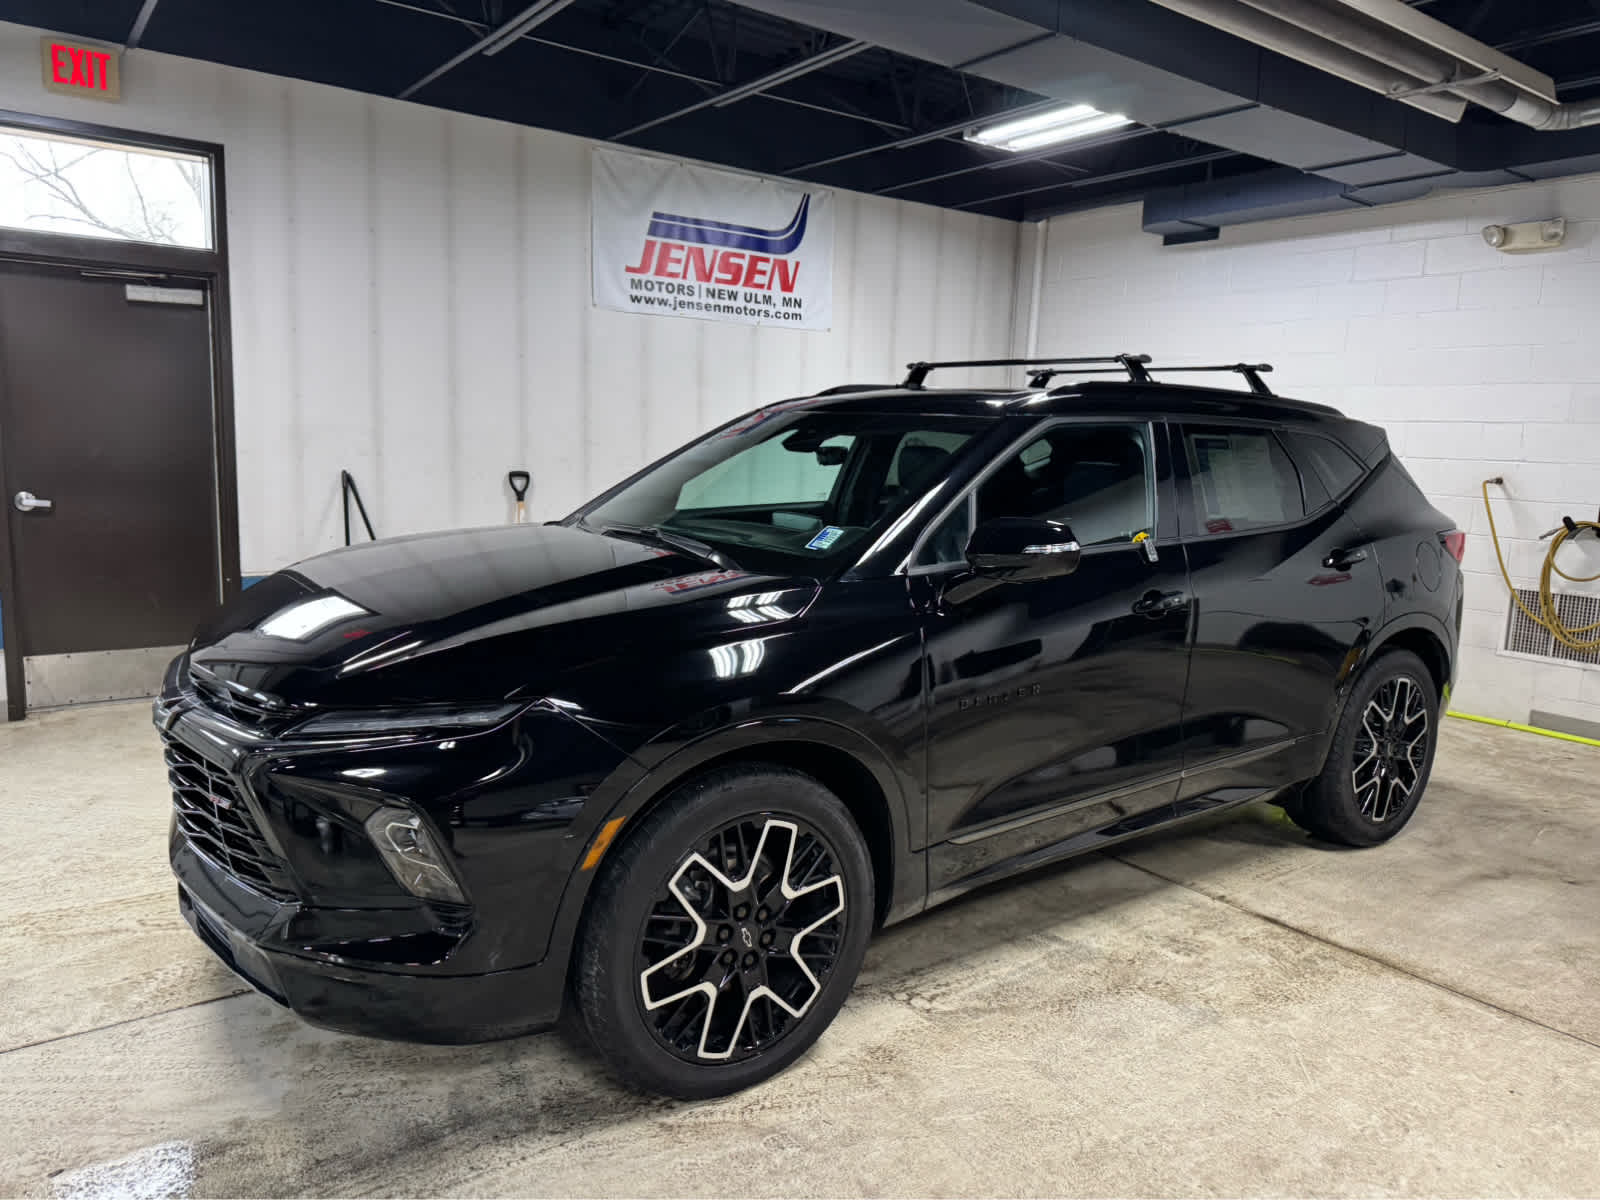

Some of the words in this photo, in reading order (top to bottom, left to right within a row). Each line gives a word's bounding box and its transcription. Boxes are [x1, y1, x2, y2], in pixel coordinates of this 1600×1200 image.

[51, 43, 111, 91] EXIT
[625, 239, 800, 293] JENSEN
[629, 294, 803, 321] www.jensenmotors.com
[630, 278, 695, 297] MOTORS
[705, 287, 738, 302] NEW
[743, 291, 776, 308] ULM,
[782, 296, 802, 309] MN
